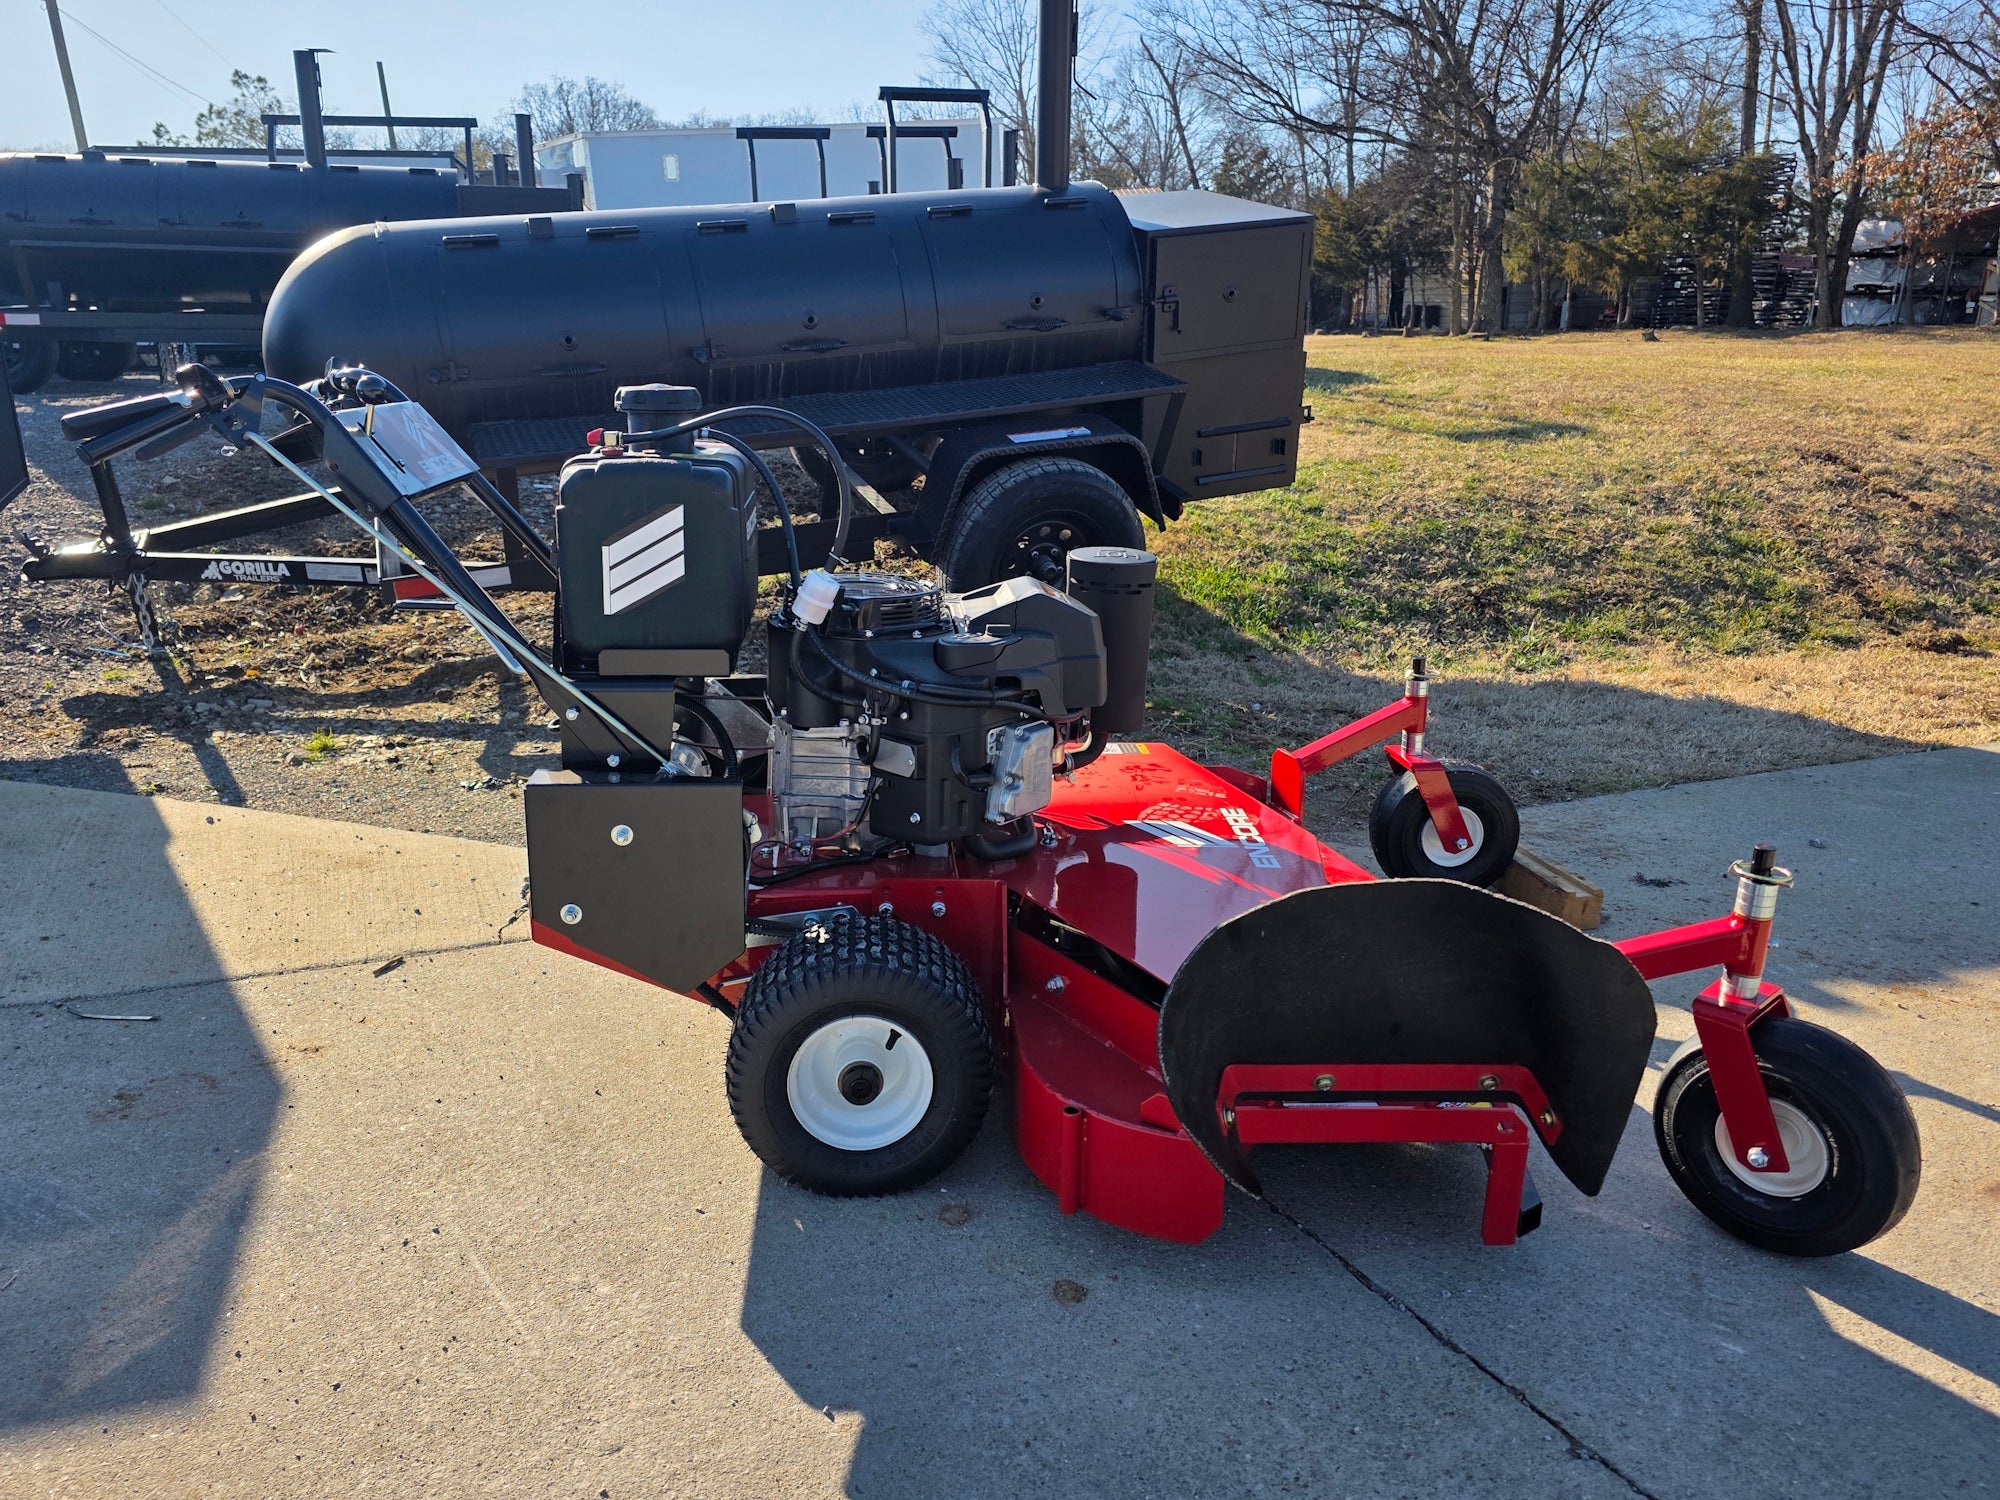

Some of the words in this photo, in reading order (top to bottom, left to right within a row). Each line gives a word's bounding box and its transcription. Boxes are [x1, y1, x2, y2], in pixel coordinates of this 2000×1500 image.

[218, 560, 291, 577] GORILLA
[233, 574, 281, 582] TRAILERS
[1219, 808, 1281, 868] ENCORE
